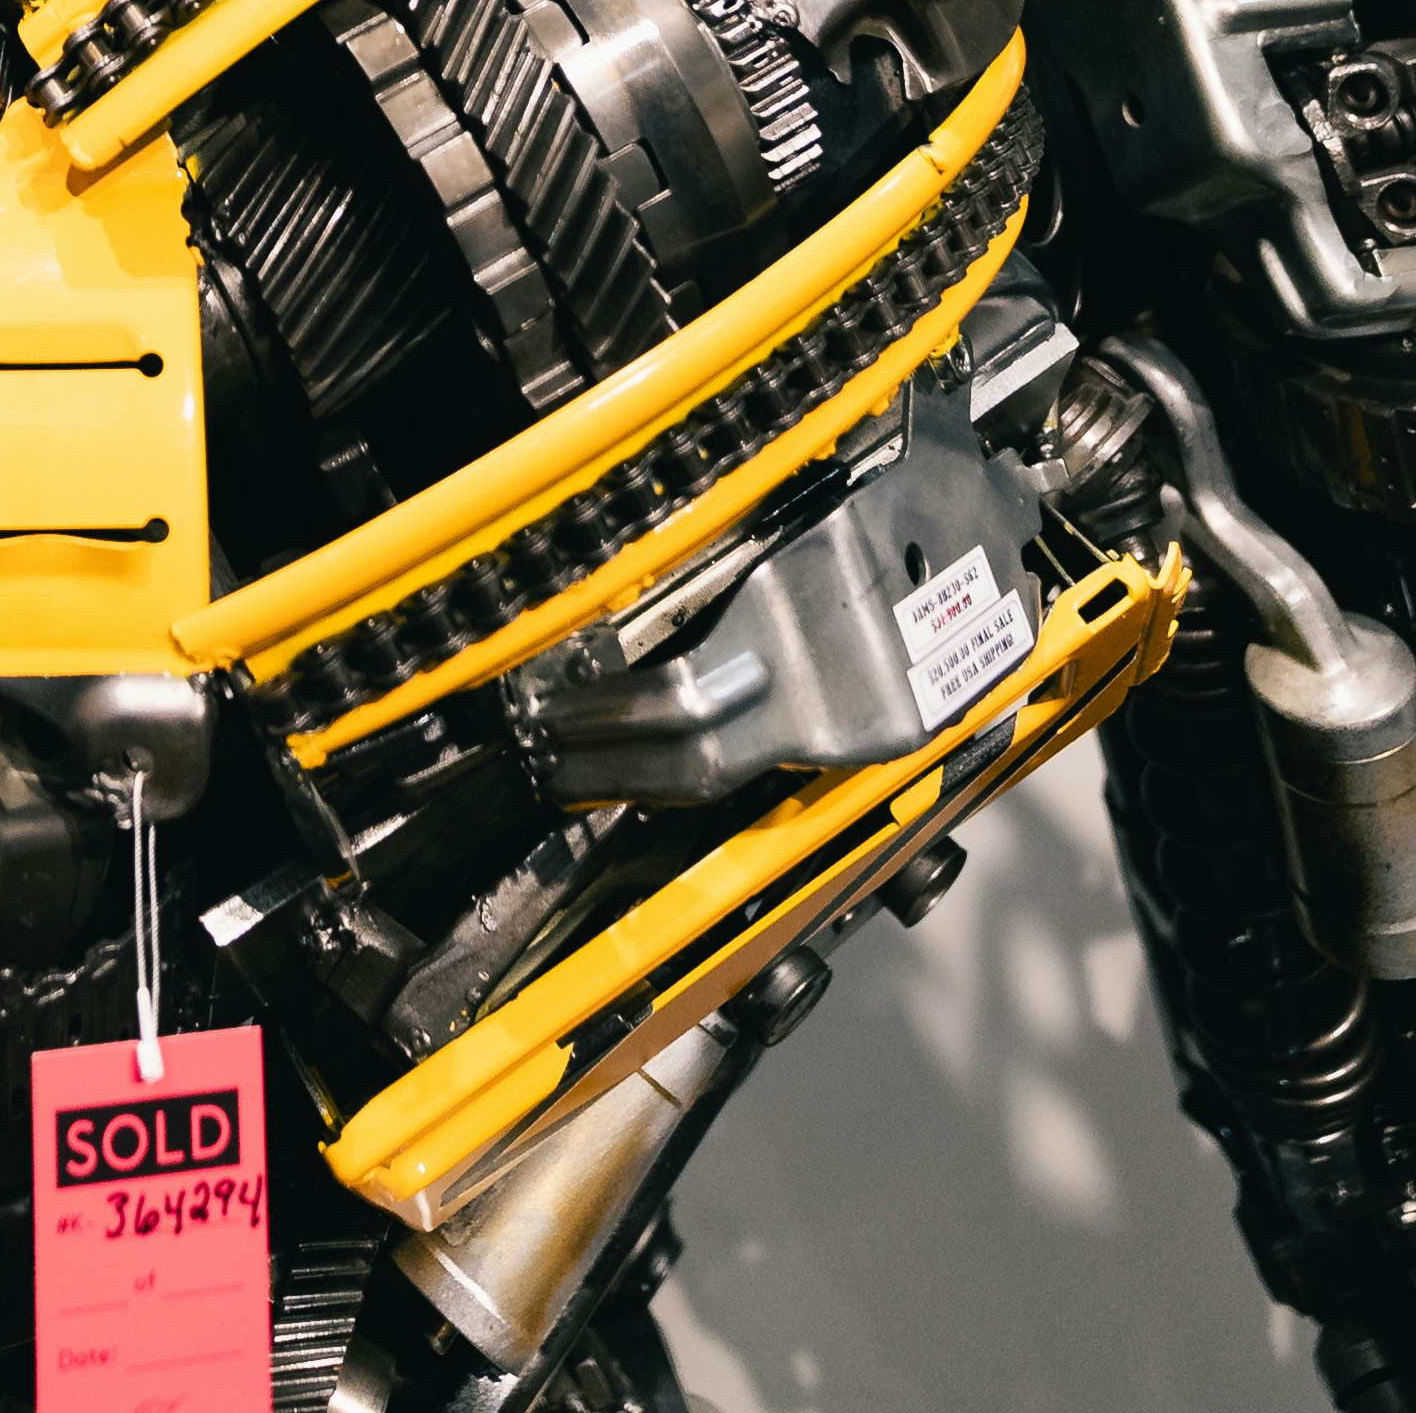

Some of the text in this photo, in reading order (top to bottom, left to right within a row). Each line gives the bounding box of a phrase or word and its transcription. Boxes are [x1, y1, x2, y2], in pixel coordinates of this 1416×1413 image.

[971, 628, 994, 652] FINAL
[994, 609, 1015, 634] SALE
[940, 633, 1016, 700] FREE USA SHIPPING!
[65, 1102, 232, 1178] SOLD
[105, 1174, 264, 1240] 364294
